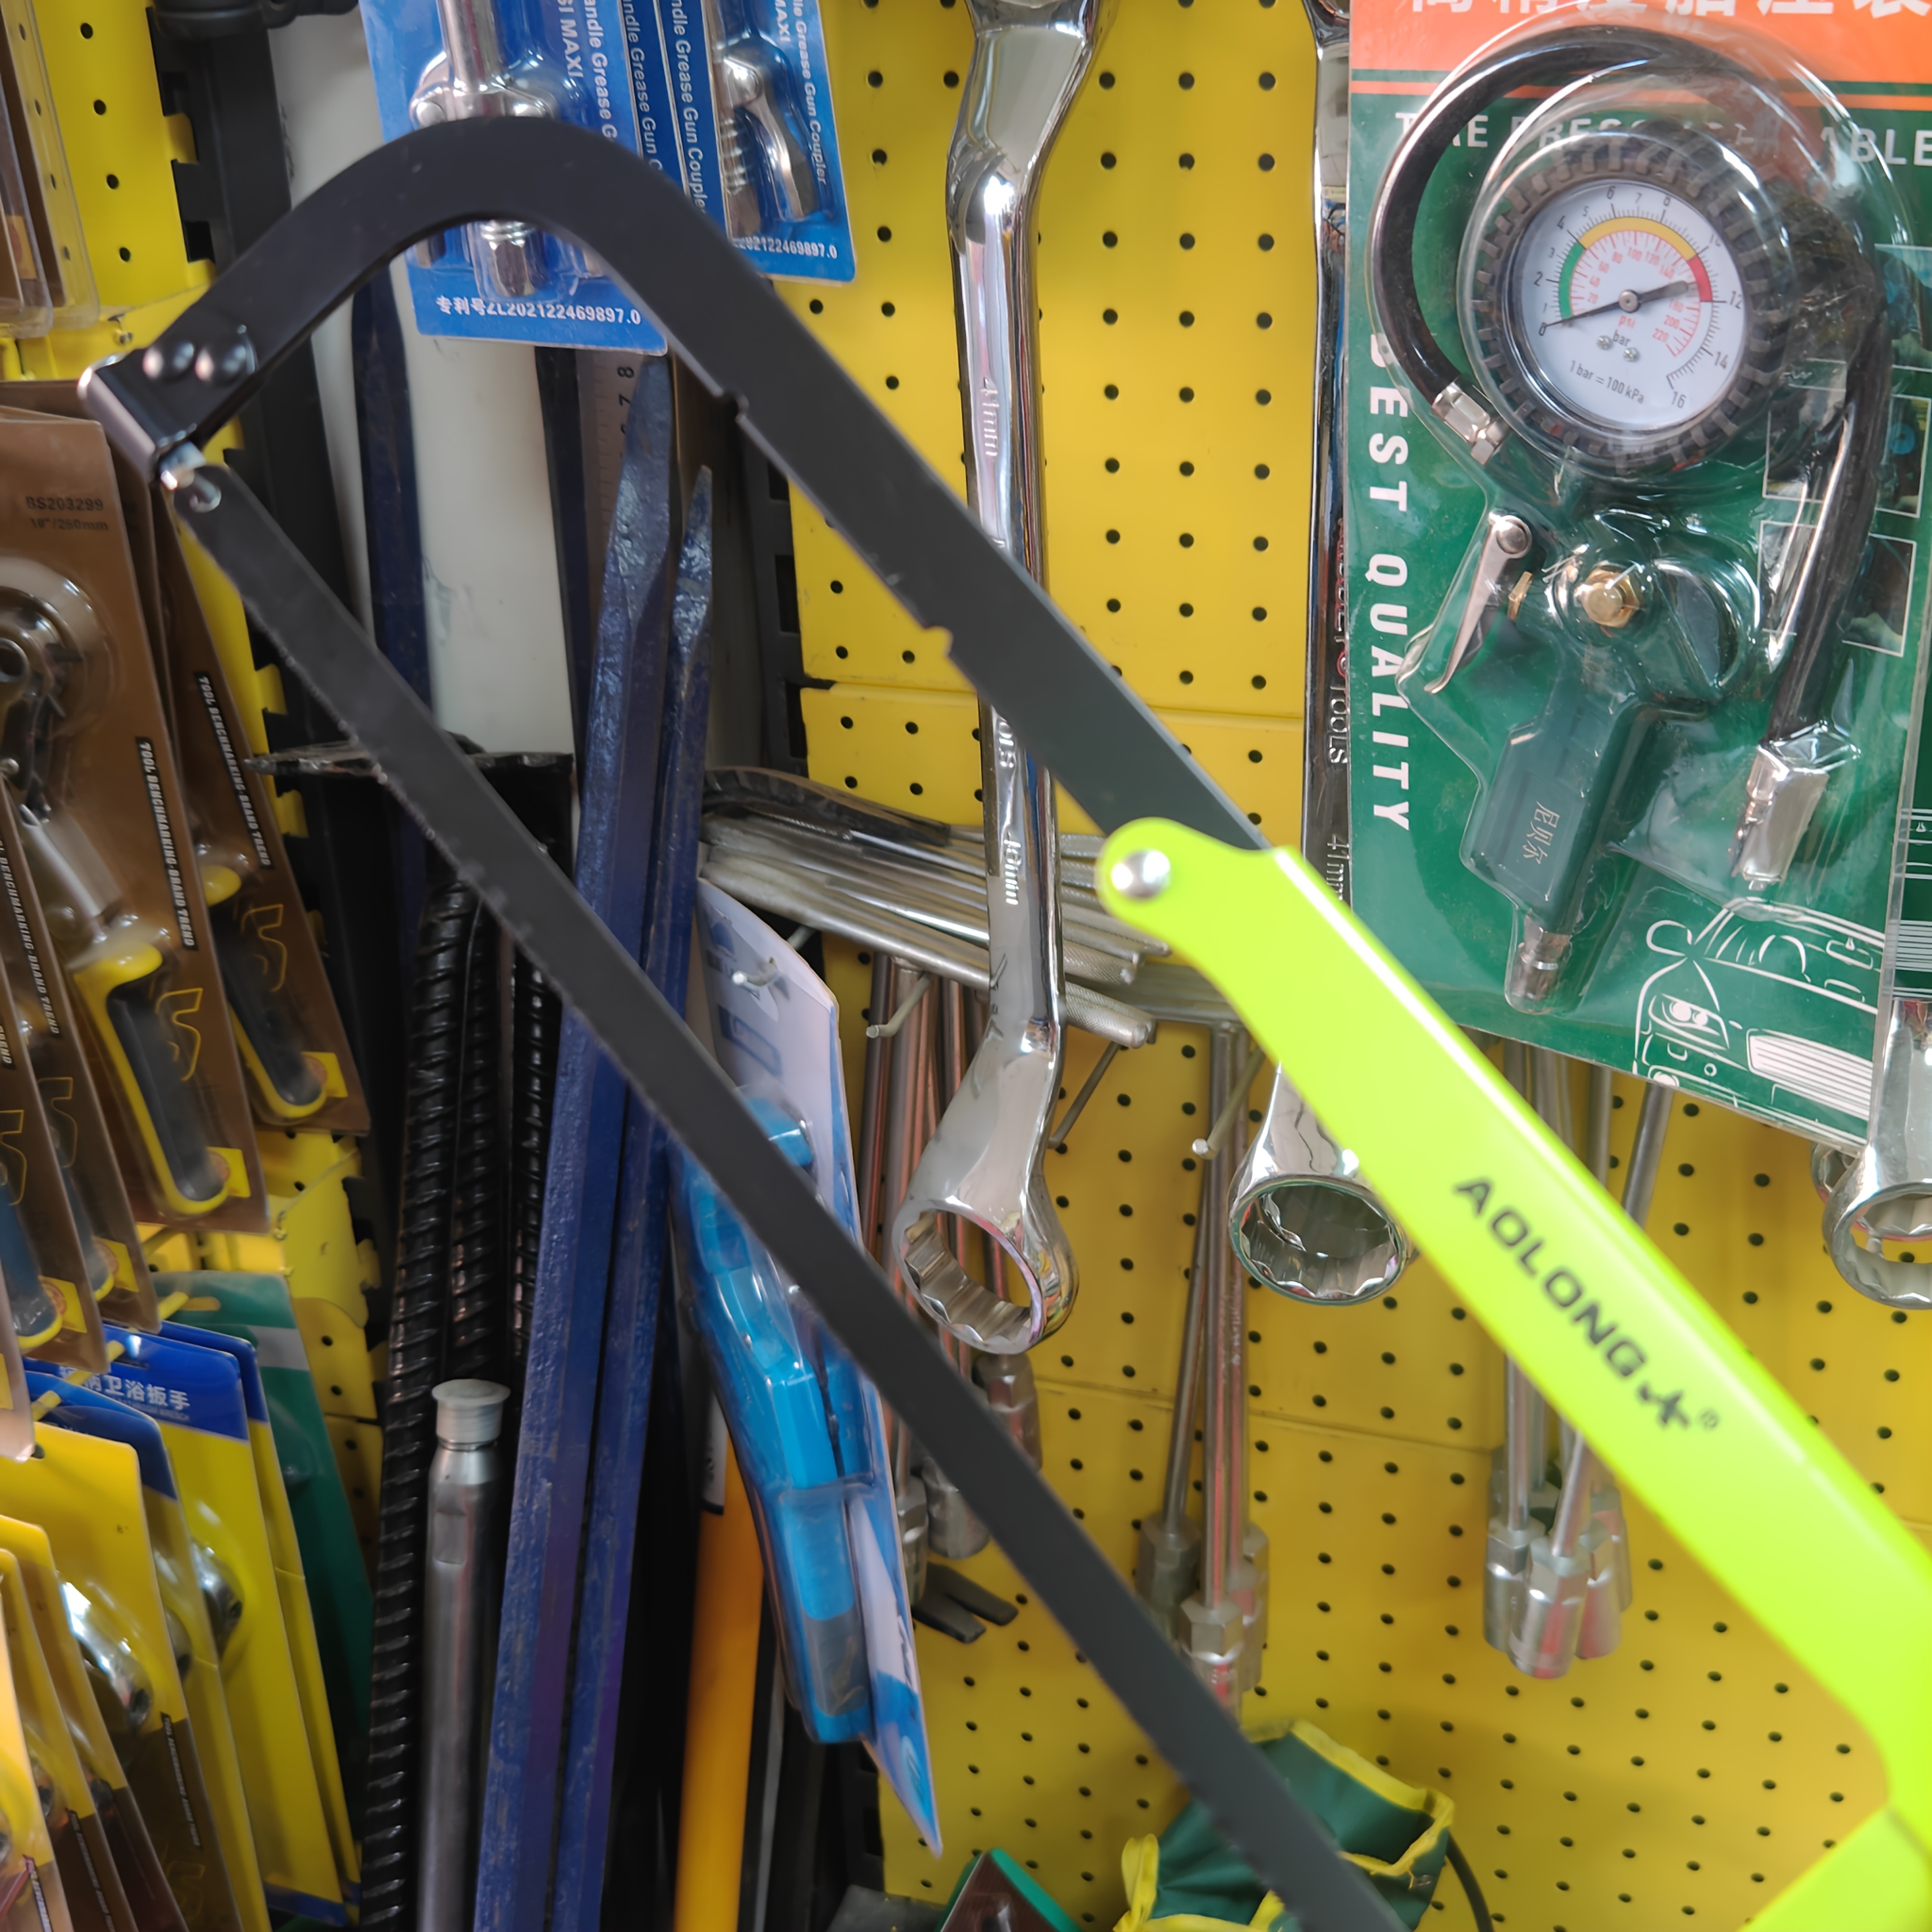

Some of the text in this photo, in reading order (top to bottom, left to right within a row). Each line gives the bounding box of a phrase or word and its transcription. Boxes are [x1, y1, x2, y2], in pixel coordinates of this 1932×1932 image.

[623, 0, 641, 43] ndle
[560, 19, 584, 78] MAXI
[795, 20, 811, 79] Grease
[591, 52, 612, 119] Grease
[630, 47, 650, 112] Grease
[675, 40, 693, 103] Grease
[804, 82, 817, 117] Gun
[642, 117, 657, 154] Gun
[683, 107, 699, 143] Gun
[810, 119, 826, 186] Coupler
[688, 147, 708, 214] Couple
[1606, 186, 1616, 200] 6
[1533, 271, 1543, 286] 2
[1729, 291, 1741, 310] 12
[1613, 330, 1631, 347] bar
[1618, 315, 1636, 328] psi
[1652, 328, 1668, 342] 220
[617, 367, 634, 378] 8
[1715, 351, 1728, 369] 14
[1570, 360, 1576, 372] 1
[1576, 363, 1594, 380] bar
[1607, 377, 1626, 394] 100
[1625, 383, 1644, 404] kPa
[1672, 391, 1686, 409] 16
[26, 496, 103, 511] BS203299
[1365, 553, 1409, 831] QUALITY
[199, 676, 216, 705] TOOL
[252, 832, 271, 865] TREND
[140, 743, 156, 773] TOOL
[177, 909, 195, 946] TREND
[1522, 801, 1560, 864] 尼贝尔
[42, 996, 60, 1034] TREND
[1454, 1177, 1646, 1378] AOLONG
